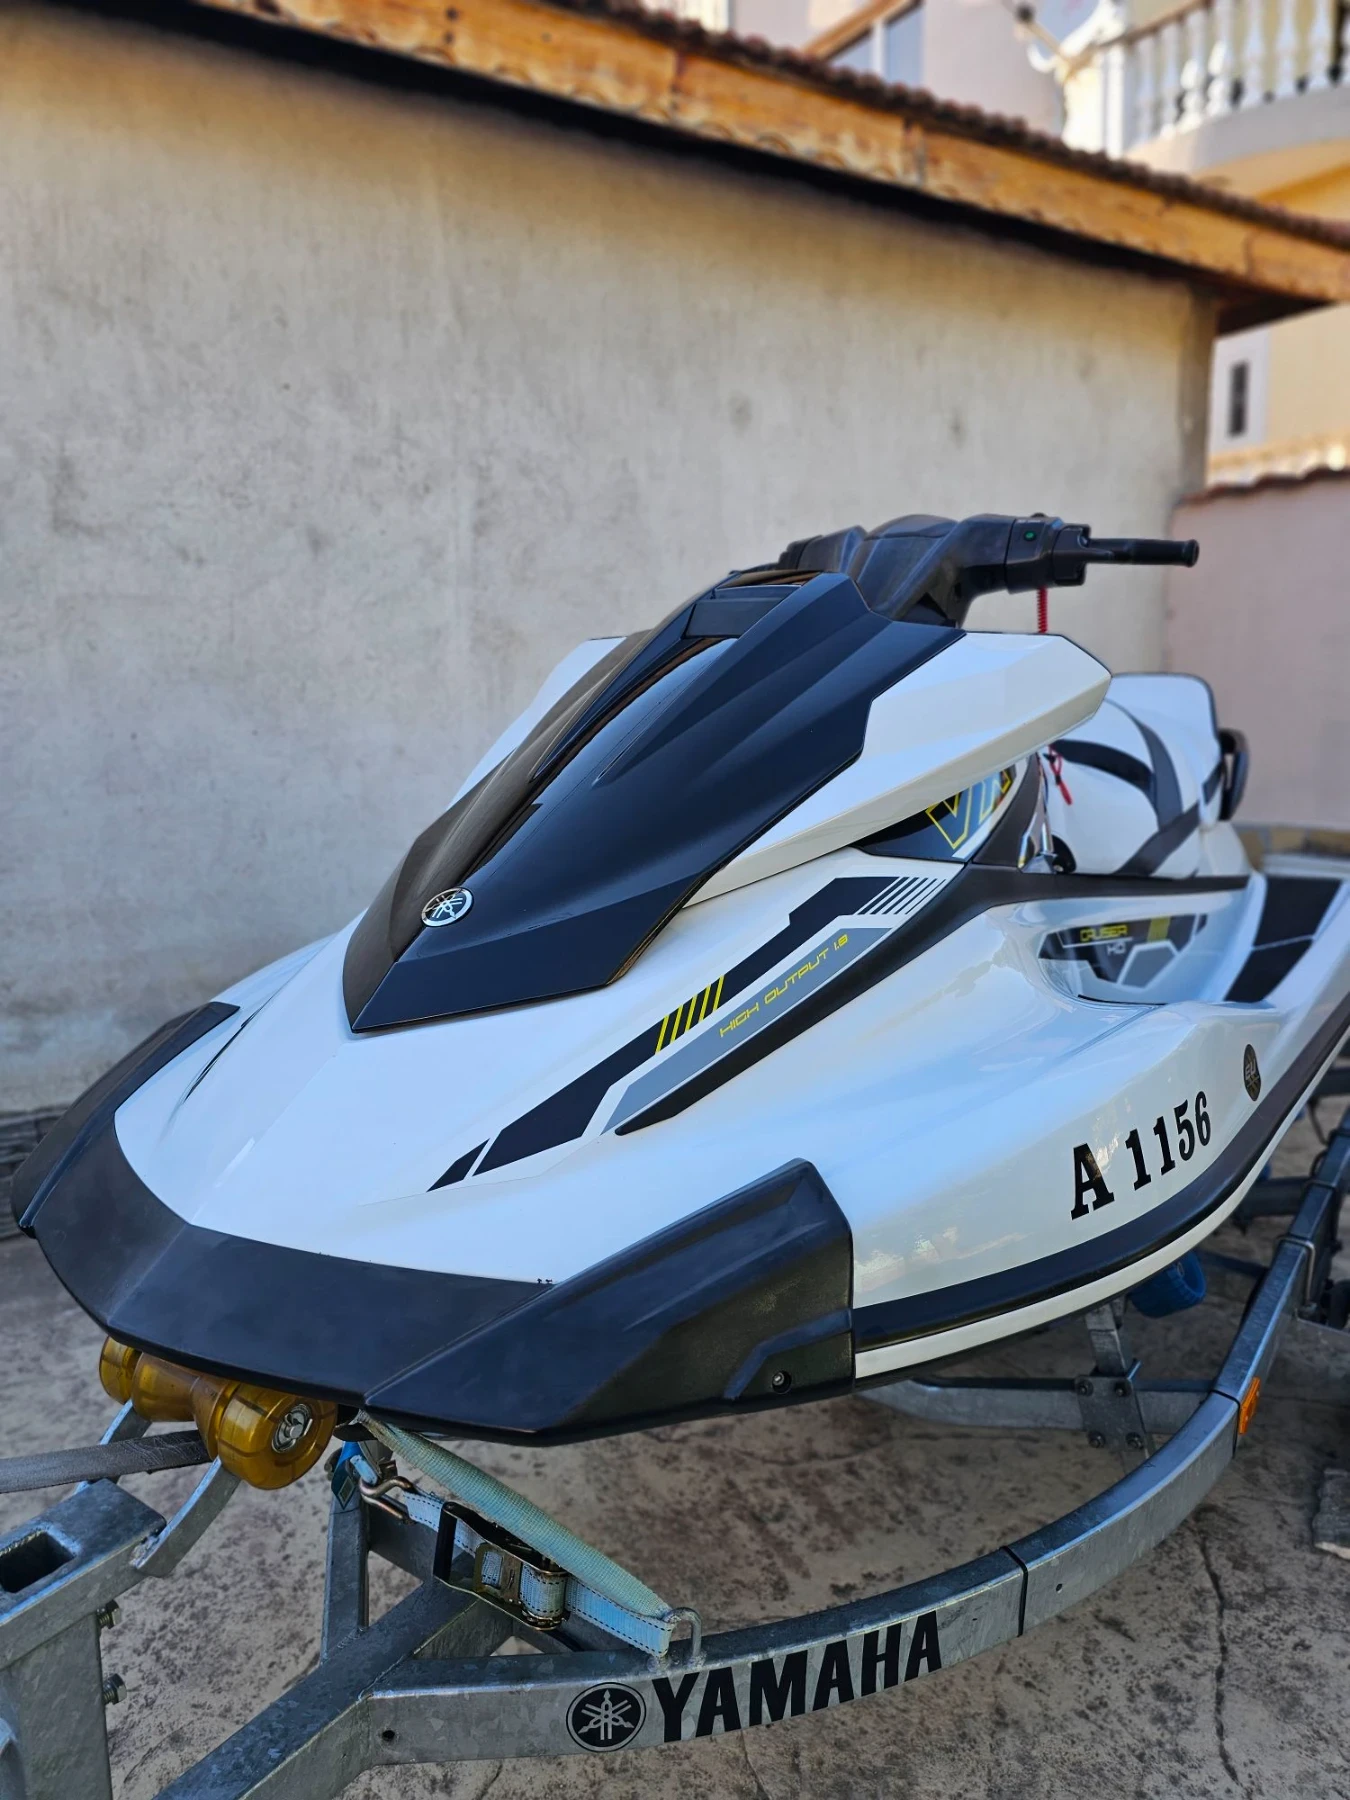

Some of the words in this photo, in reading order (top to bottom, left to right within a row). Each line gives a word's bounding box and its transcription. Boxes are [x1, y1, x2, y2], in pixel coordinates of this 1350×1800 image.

[719, 1002, 760, 1038] HIGH
[764, 948, 829, 1005] OUTPUT
[833, 933, 848, 951] 1.8
[1070, 1142, 1115, 1220] A
[1125, 1090, 1211, 1191] 1156
[651, 1610, 942, 1743] YAMAHA
